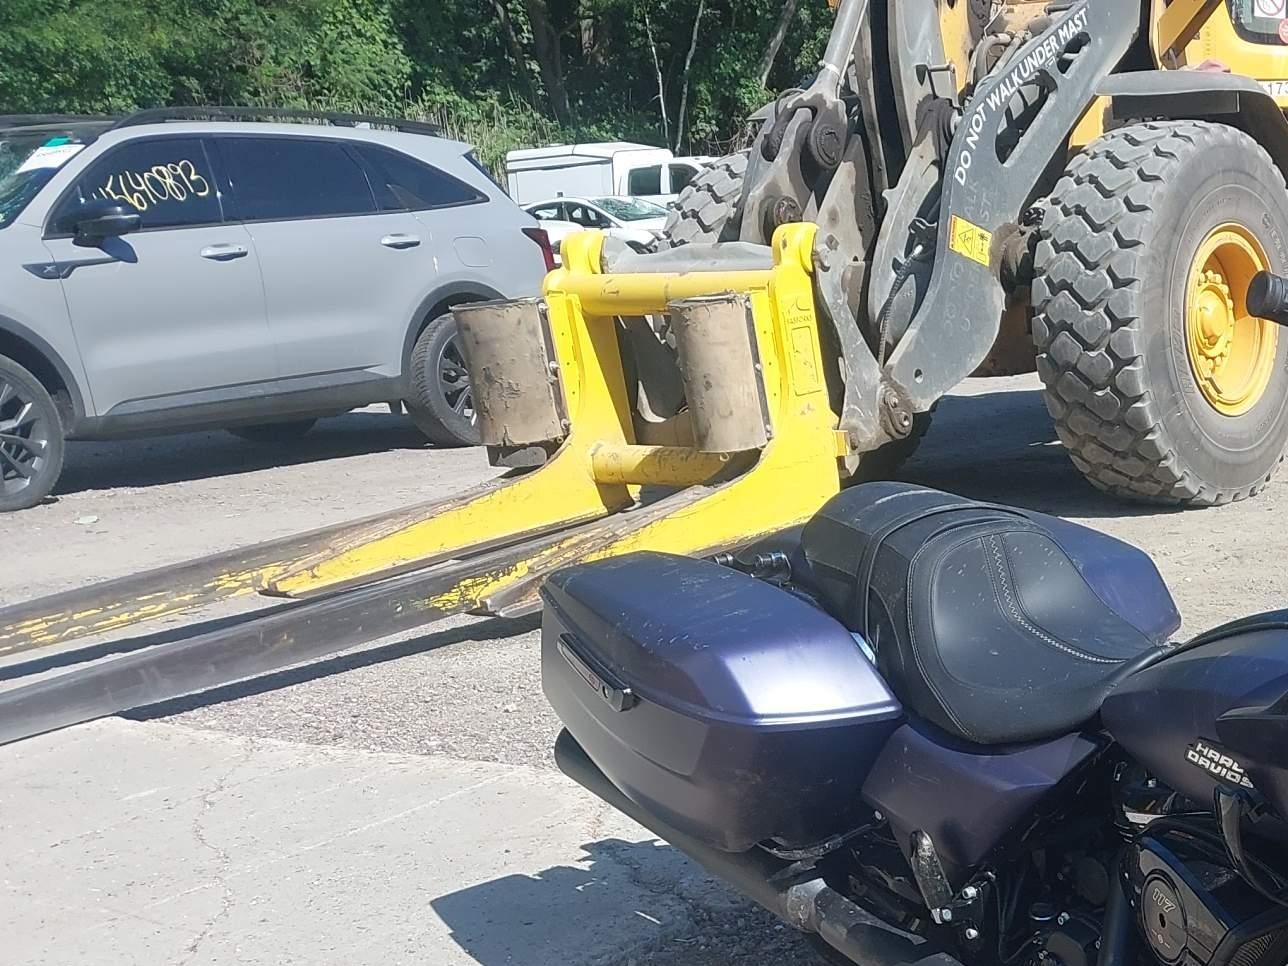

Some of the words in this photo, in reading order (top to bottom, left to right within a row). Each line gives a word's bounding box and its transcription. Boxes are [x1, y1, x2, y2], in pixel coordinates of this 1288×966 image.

[954, 151, 972, 187] DO
[966, 102, 988, 150] NOT
[985, 69, 1023, 112] WALK
[1018, 35, 1060, 79] UNDER
[1057, 7, 1088, 45] MAST
[1152, 887, 1177, 913] 117
